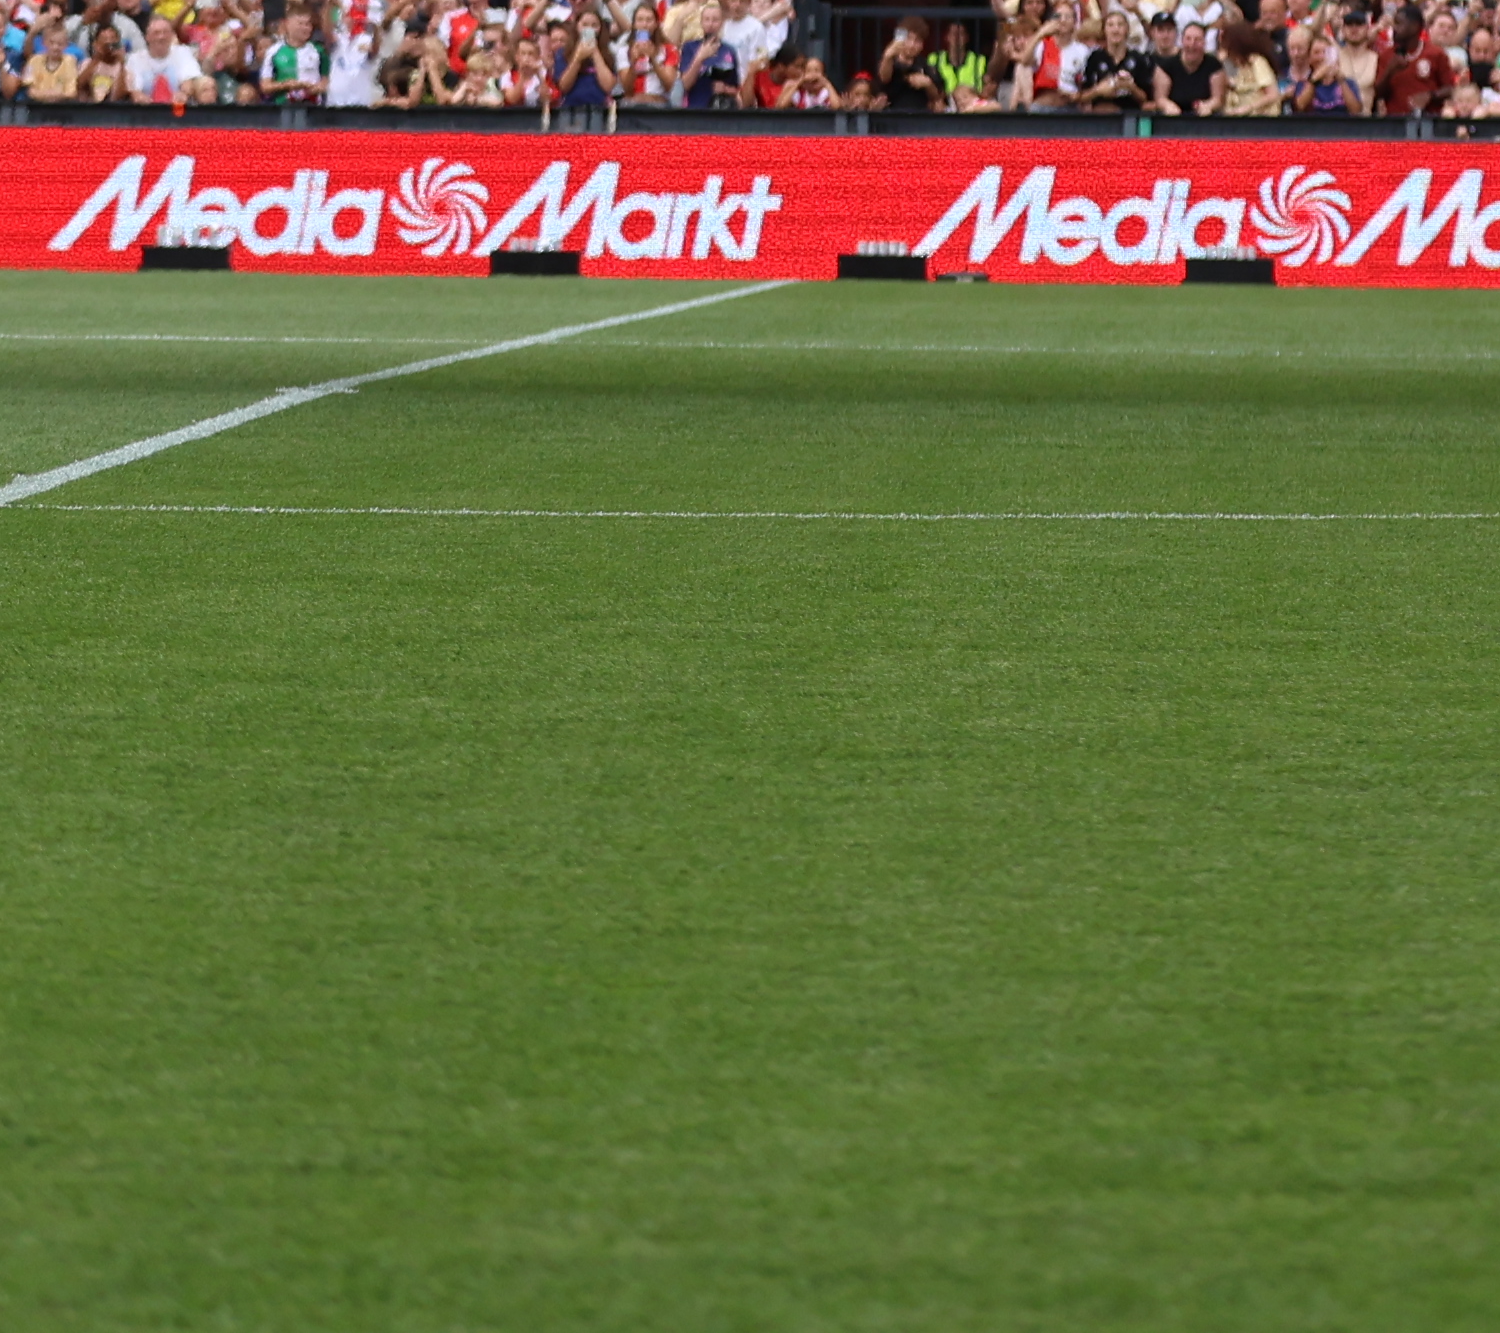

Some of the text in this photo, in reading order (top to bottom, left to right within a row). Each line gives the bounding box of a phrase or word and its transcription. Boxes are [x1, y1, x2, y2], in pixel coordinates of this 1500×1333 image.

[47, 155, 782, 261] Media Markt
[911, 165, 1246, 265] Media
